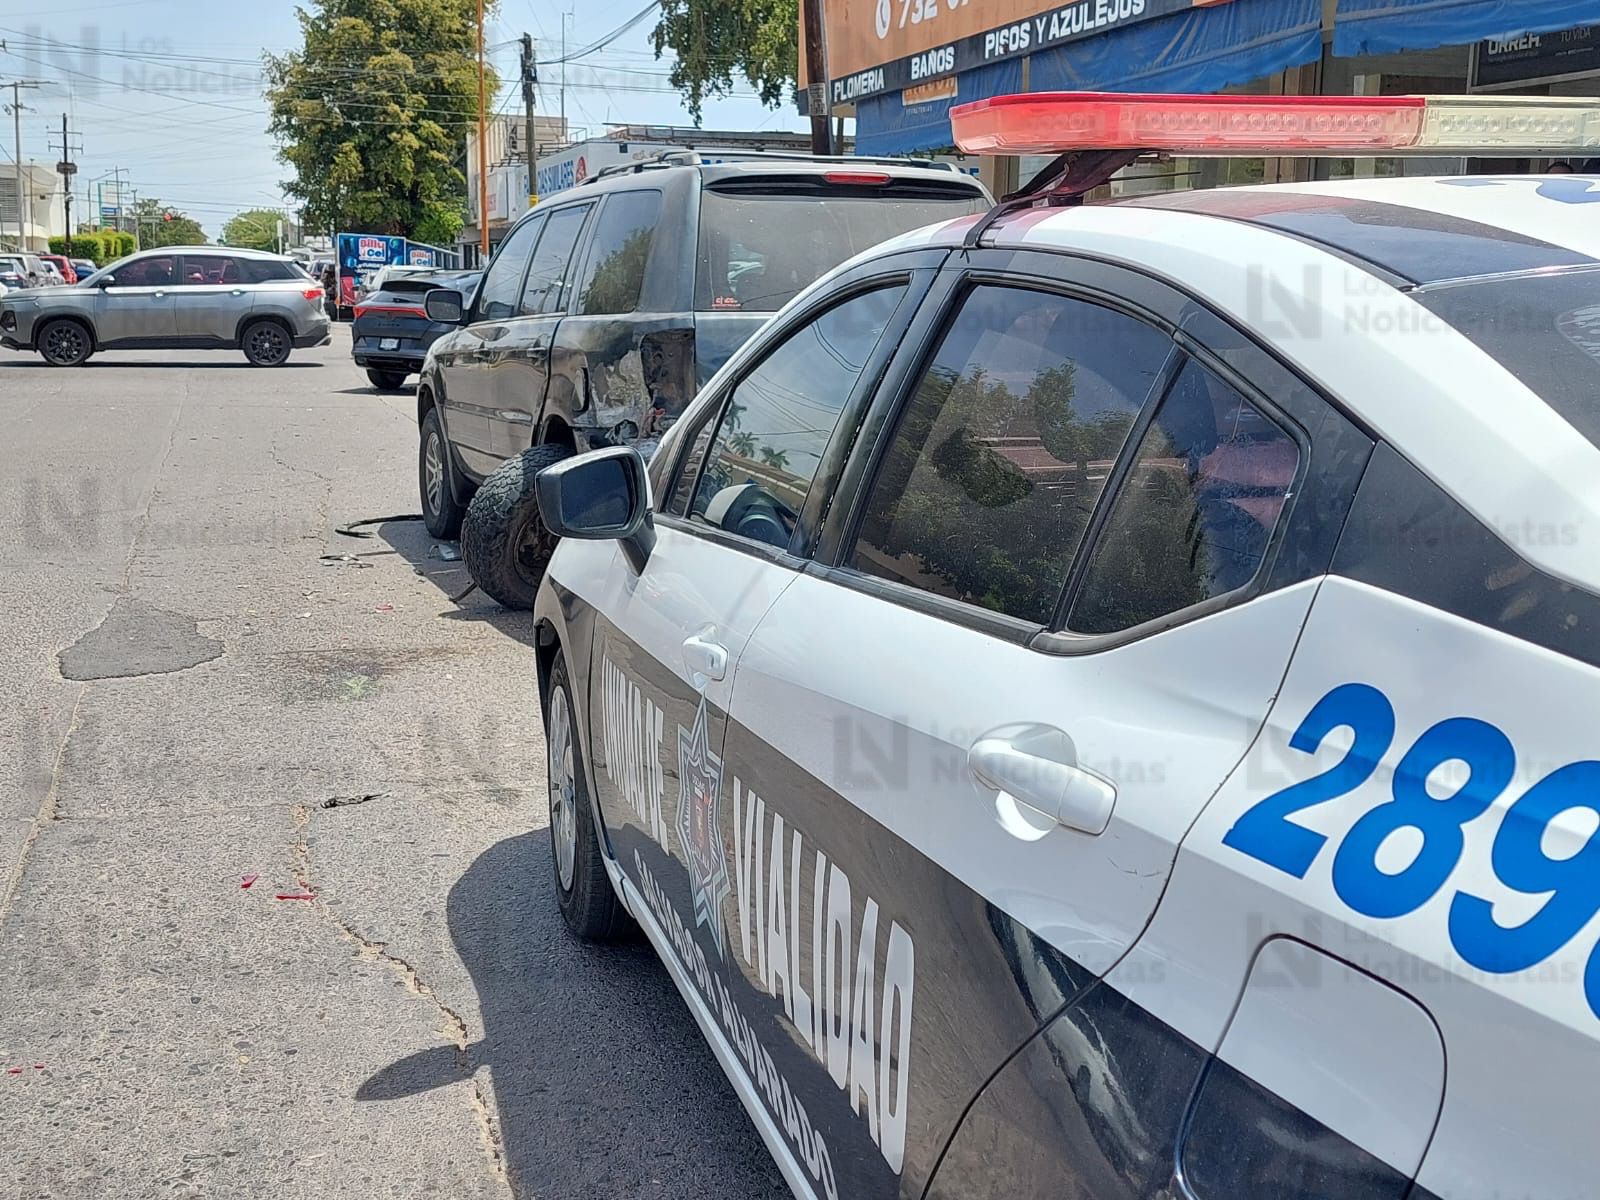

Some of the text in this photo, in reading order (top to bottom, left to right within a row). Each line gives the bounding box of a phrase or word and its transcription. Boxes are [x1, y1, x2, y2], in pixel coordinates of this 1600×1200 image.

[834, 68, 885, 102] PLOMERIA
[911, 46, 955, 80] BAÑOS
[985, 0, 1146, 59] PISOS Y AZULEJOS
[602, 653, 915, 1176] UNIDAD DE VIALIDAD
[1221, 682, 1600, 1020] 289
[634, 848, 839, 1200] SALVADOR ALVARADO
